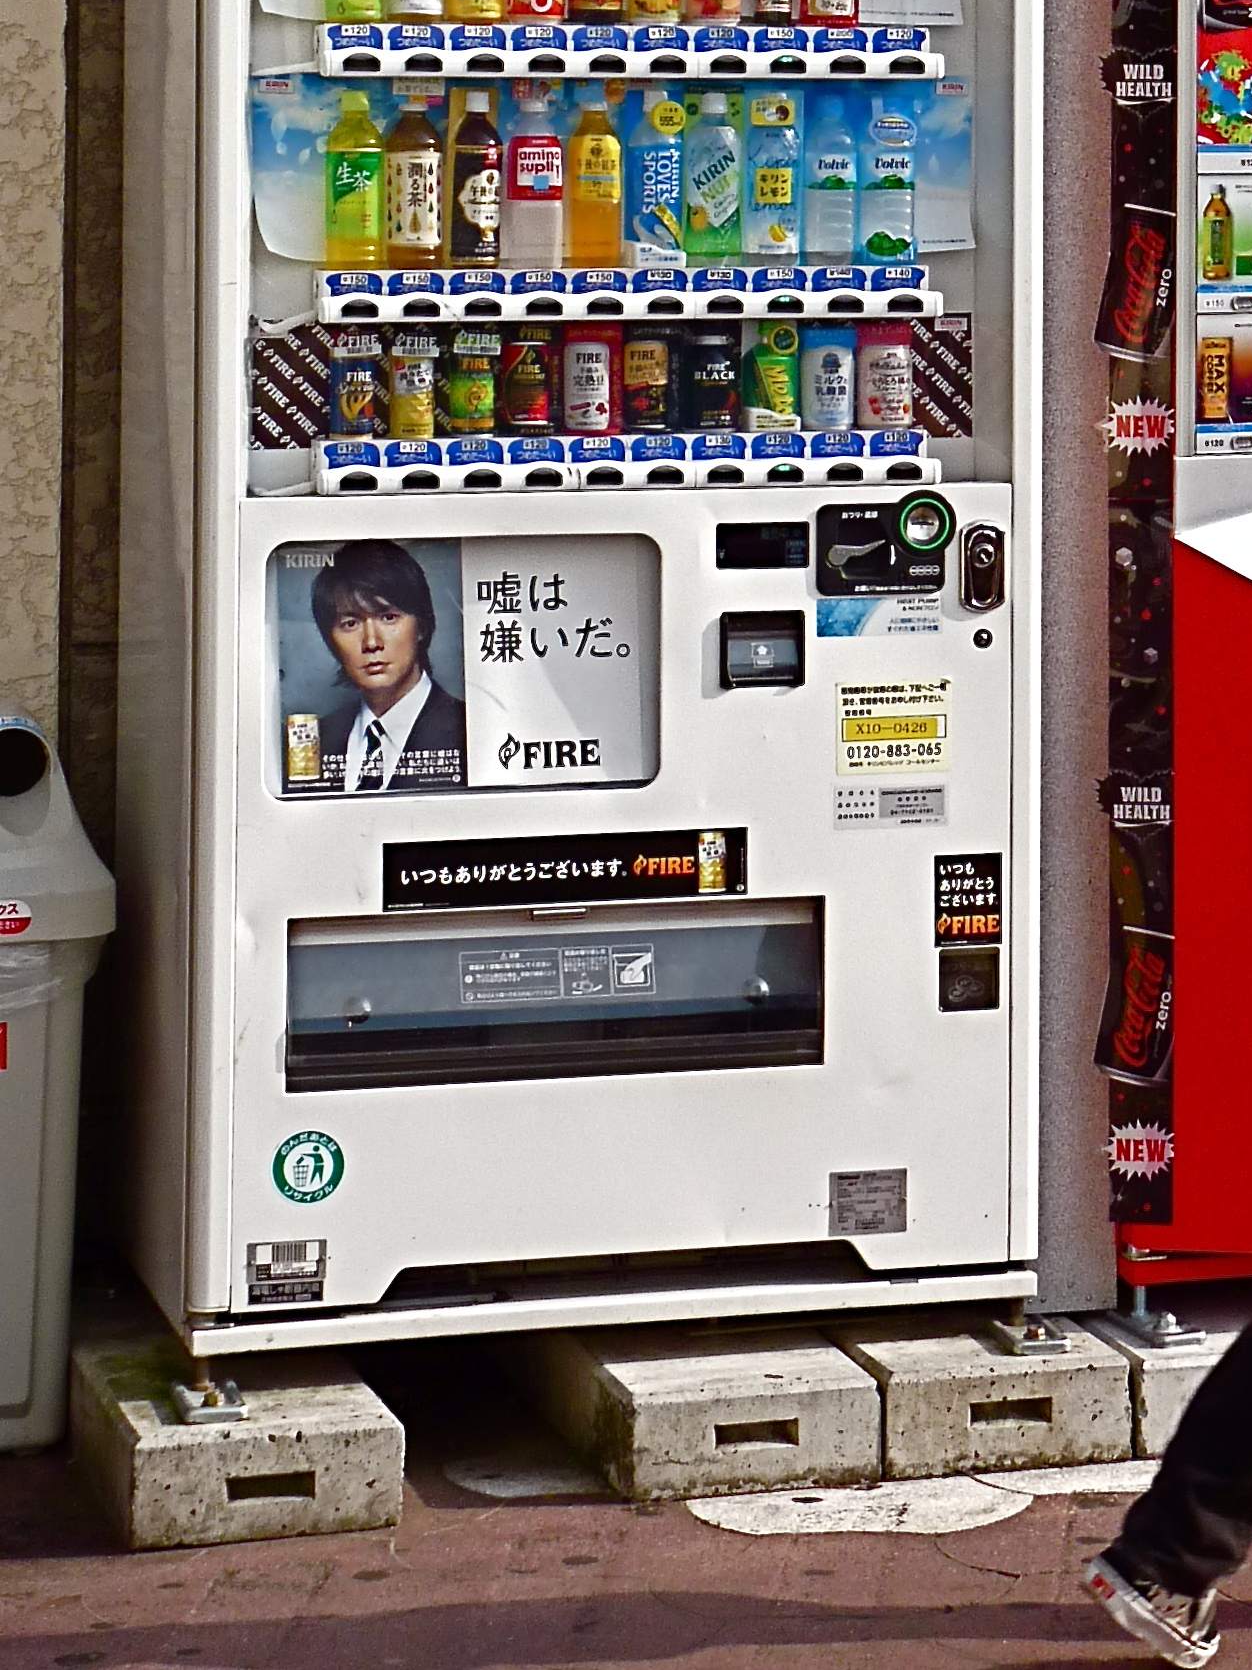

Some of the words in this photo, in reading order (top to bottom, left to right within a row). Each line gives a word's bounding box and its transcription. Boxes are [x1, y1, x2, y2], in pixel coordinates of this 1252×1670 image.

[1123, 63, 1164, 81] WILD
[1115, 81, 1173, 98] HEALTH
[518, 149, 561, 160] amino
[875, 157, 911, 170] Volvic
[336, 161, 372, 192] 生茶
[657, 152, 671, 204] LOVES
[692, 149, 736, 191] KIRIN
[760, 174, 789, 184] キリン
[643, 151, 657, 214] SPORTS
[760, 187, 789, 197] レモン
[1155, 268, 1173, 307] zero
[348, 334, 380, 347] FIRE
[406, 336, 437, 348] FIRE
[469, 333, 500, 345] FIRE
[462, 358, 490, 369] FIRE
[576, 352, 602, 364] FIRE
[630, 350, 656, 360] FIRE
[937, 346, 960, 370] FIRE
[270, 354, 296, 380] FIRE
[305, 353, 331, 380] FIRE
[346, 371, 372, 381] FIRE
[518, 364, 540, 373] FIRE
[694, 371, 735, 380] BLACK
[1214, 353, 1227, 395] MAX
[263, 381, 290, 408] FIRE
[299, 380, 325, 407] FIRE
[932, 373, 955, 397] FIRE
[292, 409, 319, 436] FIRE
[926, 401, 949, 425] FIRE
[257, 411, 284, 438] FIRE
[1116, 415, 1167, 438] NEW
[286, 553, 335, 569] KIRIN
[477, 571, 568, 615] 嘘は
[480, 617, 632, 663] 嫌いだ。
[523, 739, 601, 769] FIRE
[847, 742, 942, 759] 0120-883-065
[1120, 786, 1162, 803] WILD
[1113, 803, 1171, 820] HEALTH
[648, 856, 696, 876] FIRE
[939, 862, 975, 875] いつも
[939, 877, 995, 892] ありがとう
[951, 914, 1000, 935] FIRE
[1155, 991, 1172, 1030] zero
[1115, 1138, 1167, 1163] NEW
[283, 1183, 334, 1202] リサイクル
